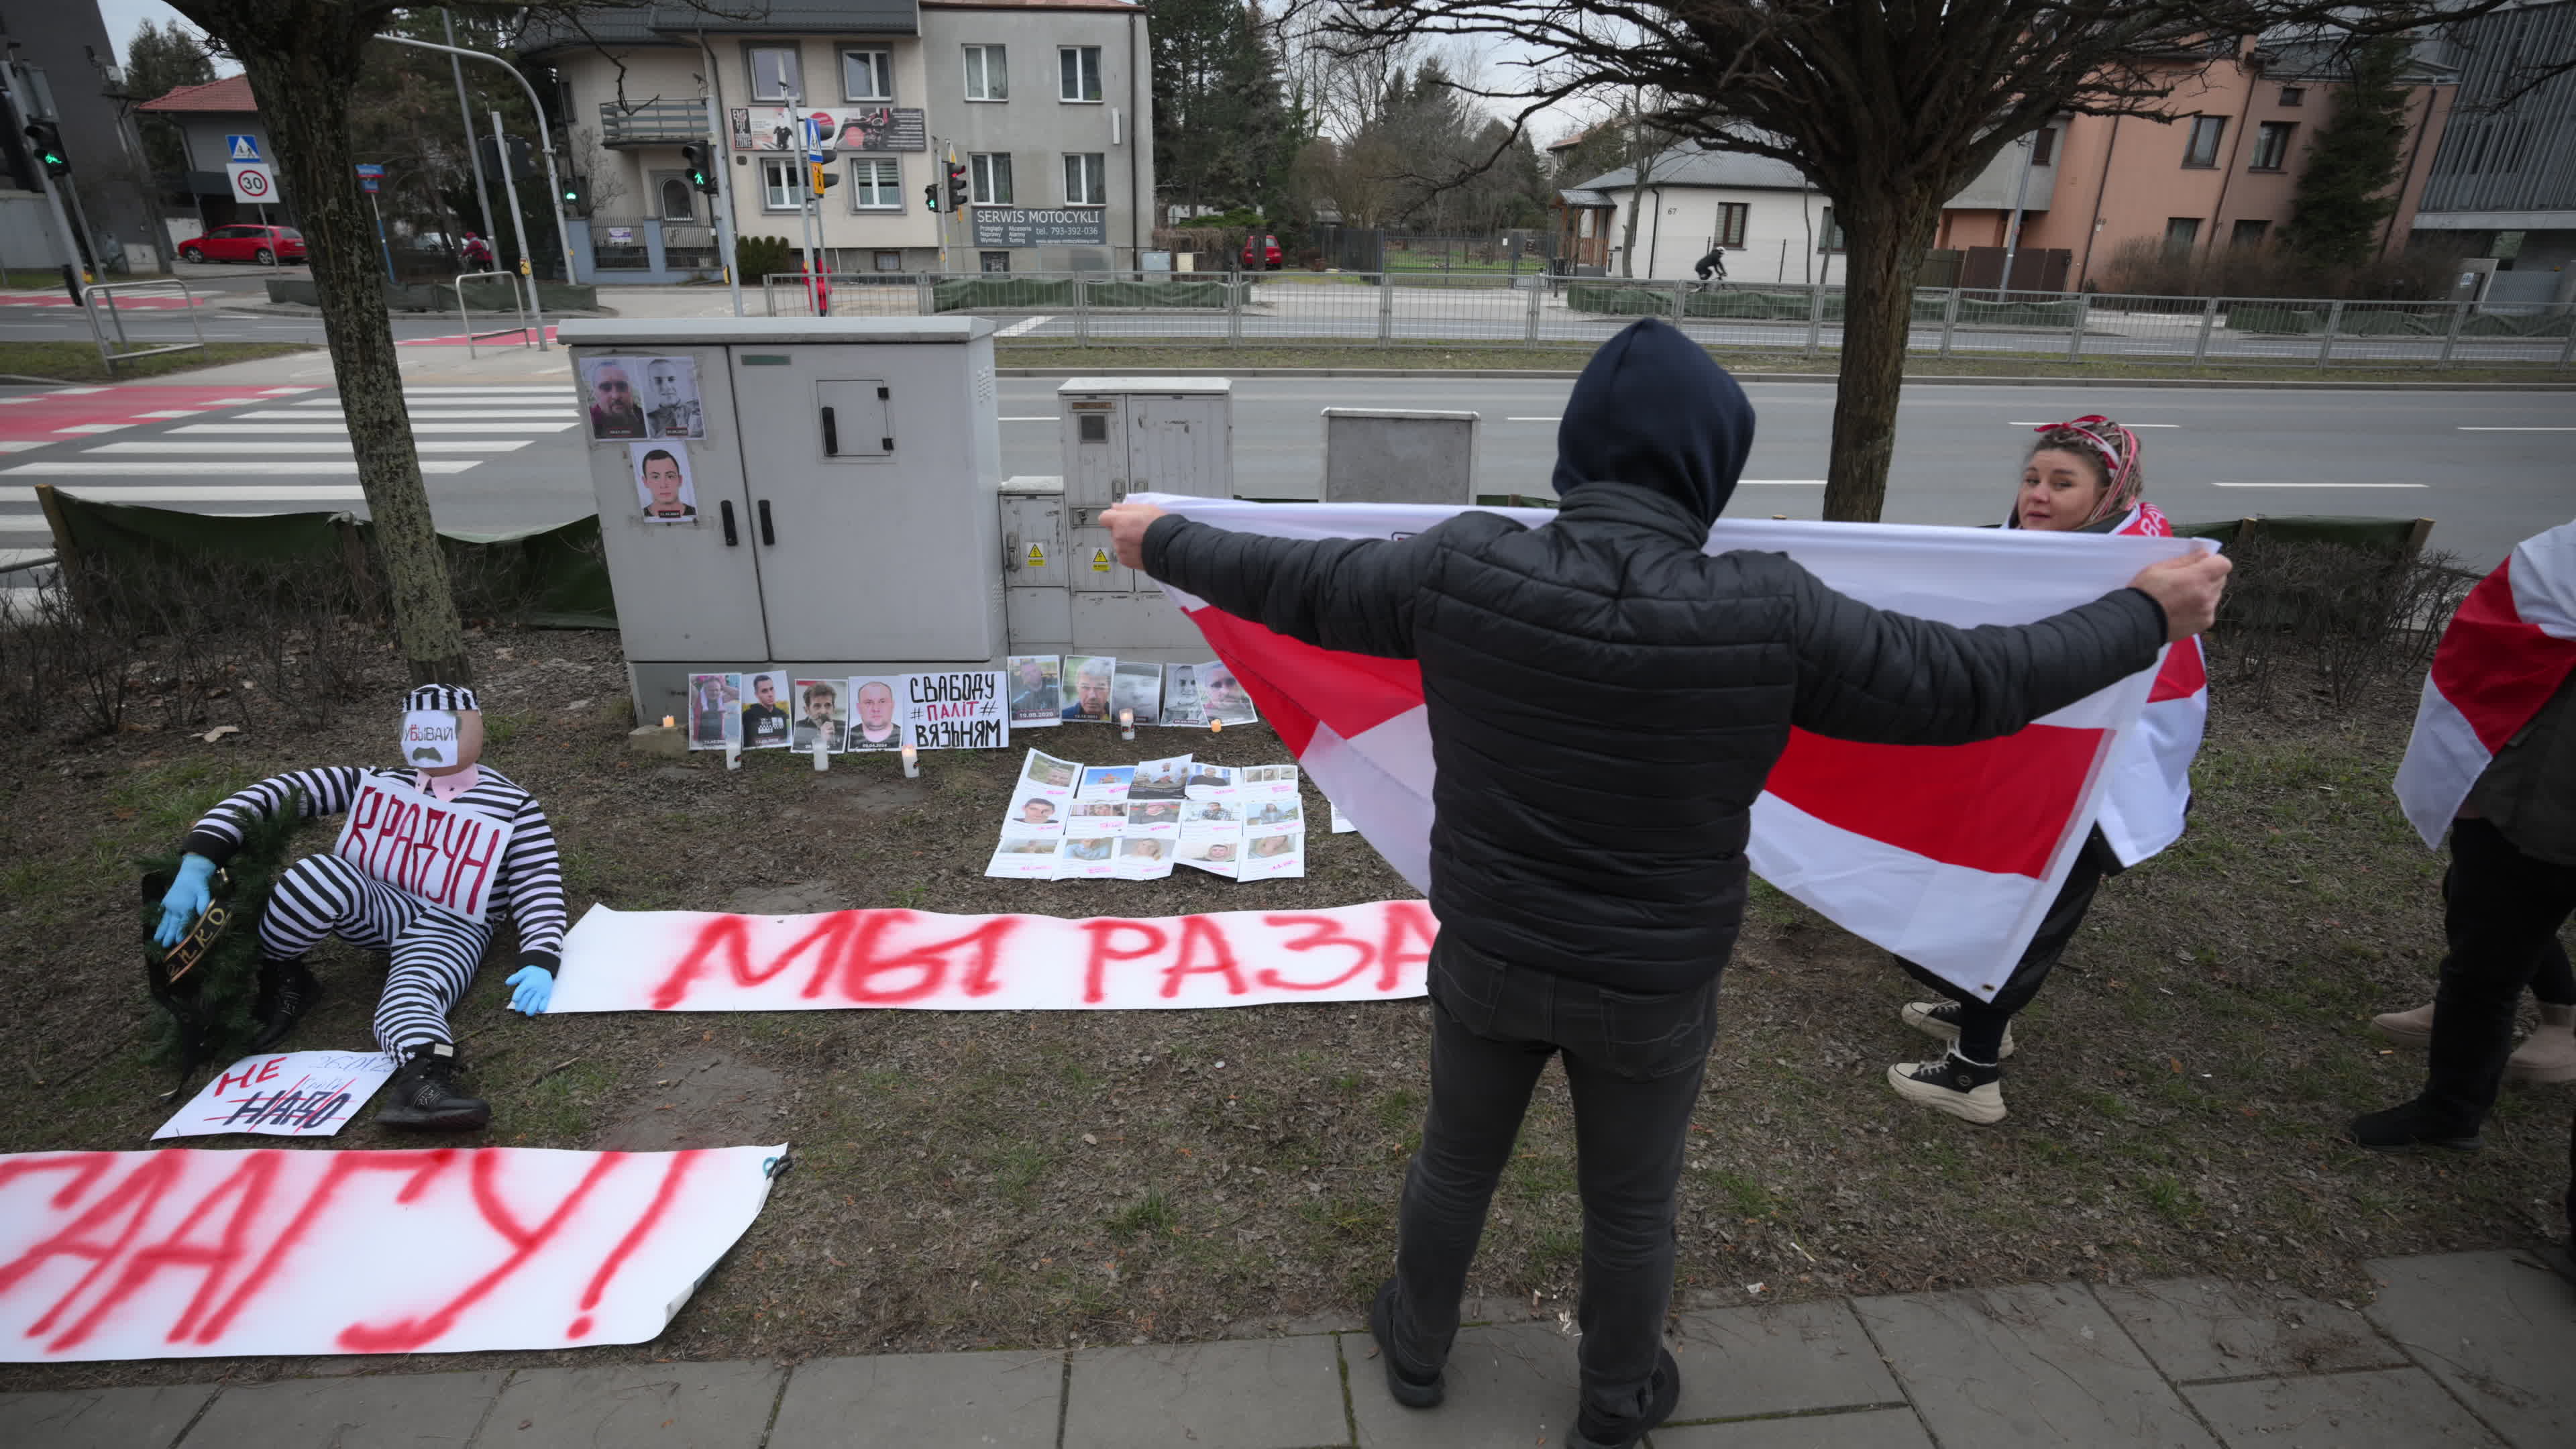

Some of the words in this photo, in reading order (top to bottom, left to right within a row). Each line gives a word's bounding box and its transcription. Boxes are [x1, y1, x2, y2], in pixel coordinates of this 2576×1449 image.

[243, 177, 262, 190] 30
[977, 211, 1025, 223] SERWIS
[1029, 211, 1099, 223] MOTOCYKLI
[1036, 227, 1048, 235] tel.
[1051, 227, 1098, 235] 793-392-036
[910, 673, 995, 703] СВАБОДУ
[915, 718, 1001, 747] ВЯЗЬНЯМ
[341, 786, 500, 915] КРАДУН
[649, 909, 1024, 1009] МЫ
[213, 1057, 288, 1097] НЕ
